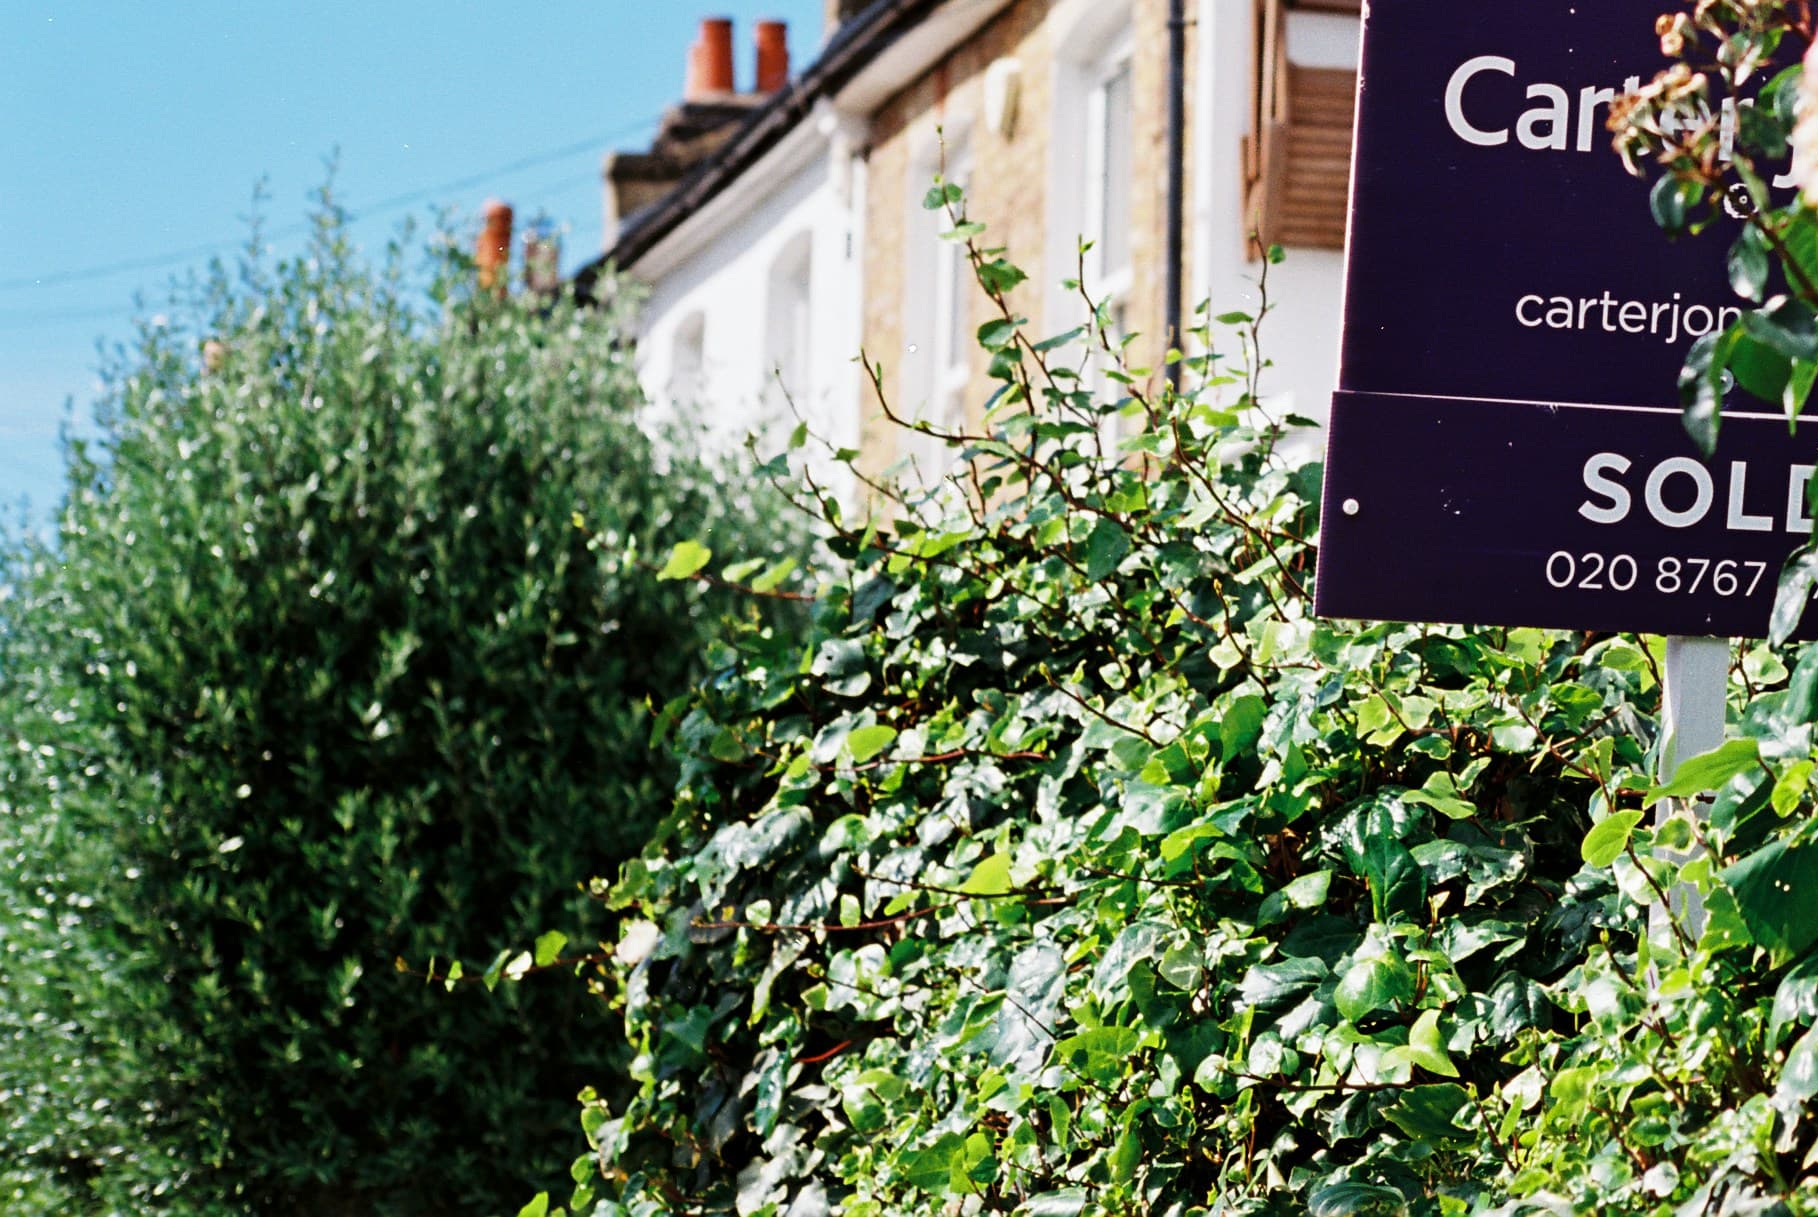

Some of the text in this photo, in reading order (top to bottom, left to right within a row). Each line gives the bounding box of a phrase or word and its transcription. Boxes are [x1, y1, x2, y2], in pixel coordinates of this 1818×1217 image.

[1444, 54, 1754, 162] Carer
[1545, 550, 1638, 591] 020
[1655, 556, 1767, 597] 8767
